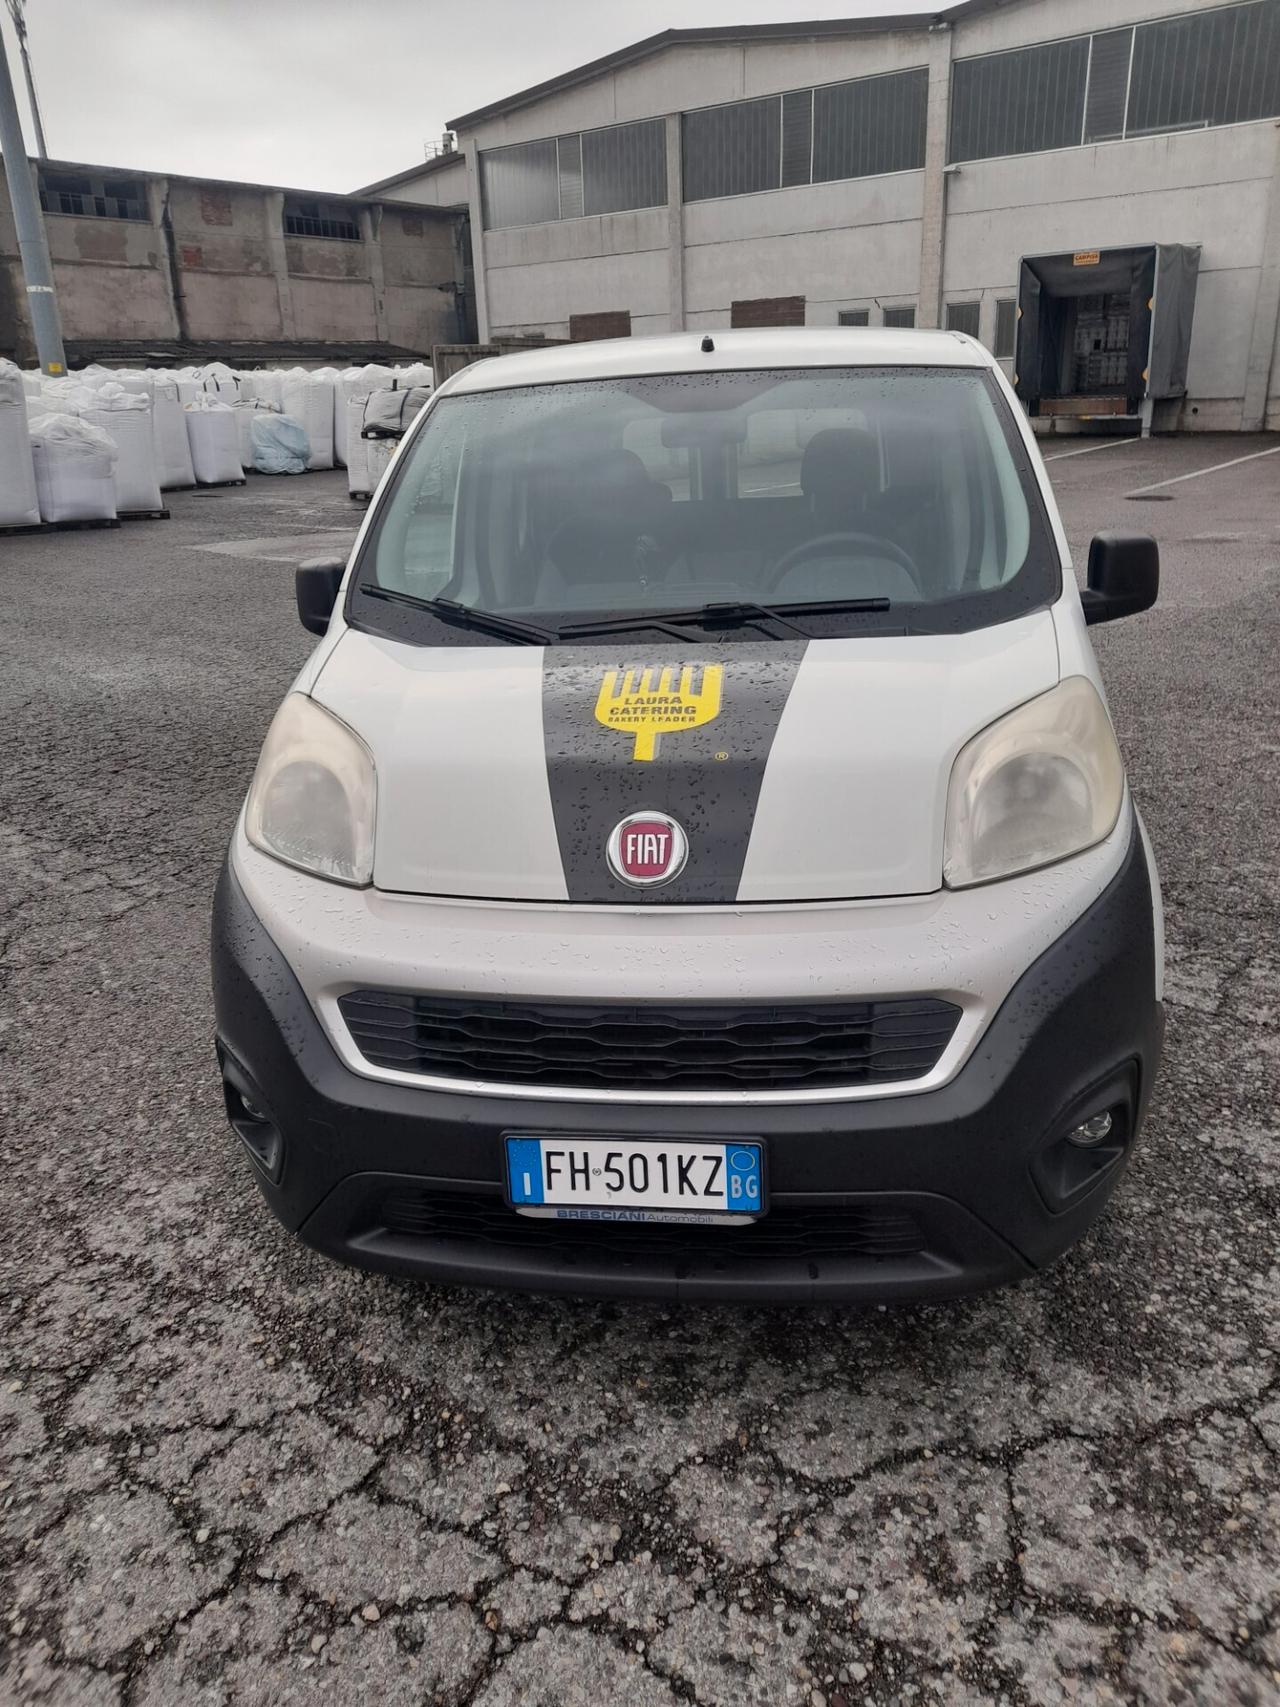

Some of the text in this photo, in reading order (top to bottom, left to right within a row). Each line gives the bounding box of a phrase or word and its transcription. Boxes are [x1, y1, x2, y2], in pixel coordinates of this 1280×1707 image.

[624, 696, 682, 705] LAURA
[610, 706, 697, 715] CATERING
[627, 834, 669, 865] FIAT
[731, 1175, 758, 1199] BG
[557, 1210, 714, 1224] BRESCIANI Automobili
